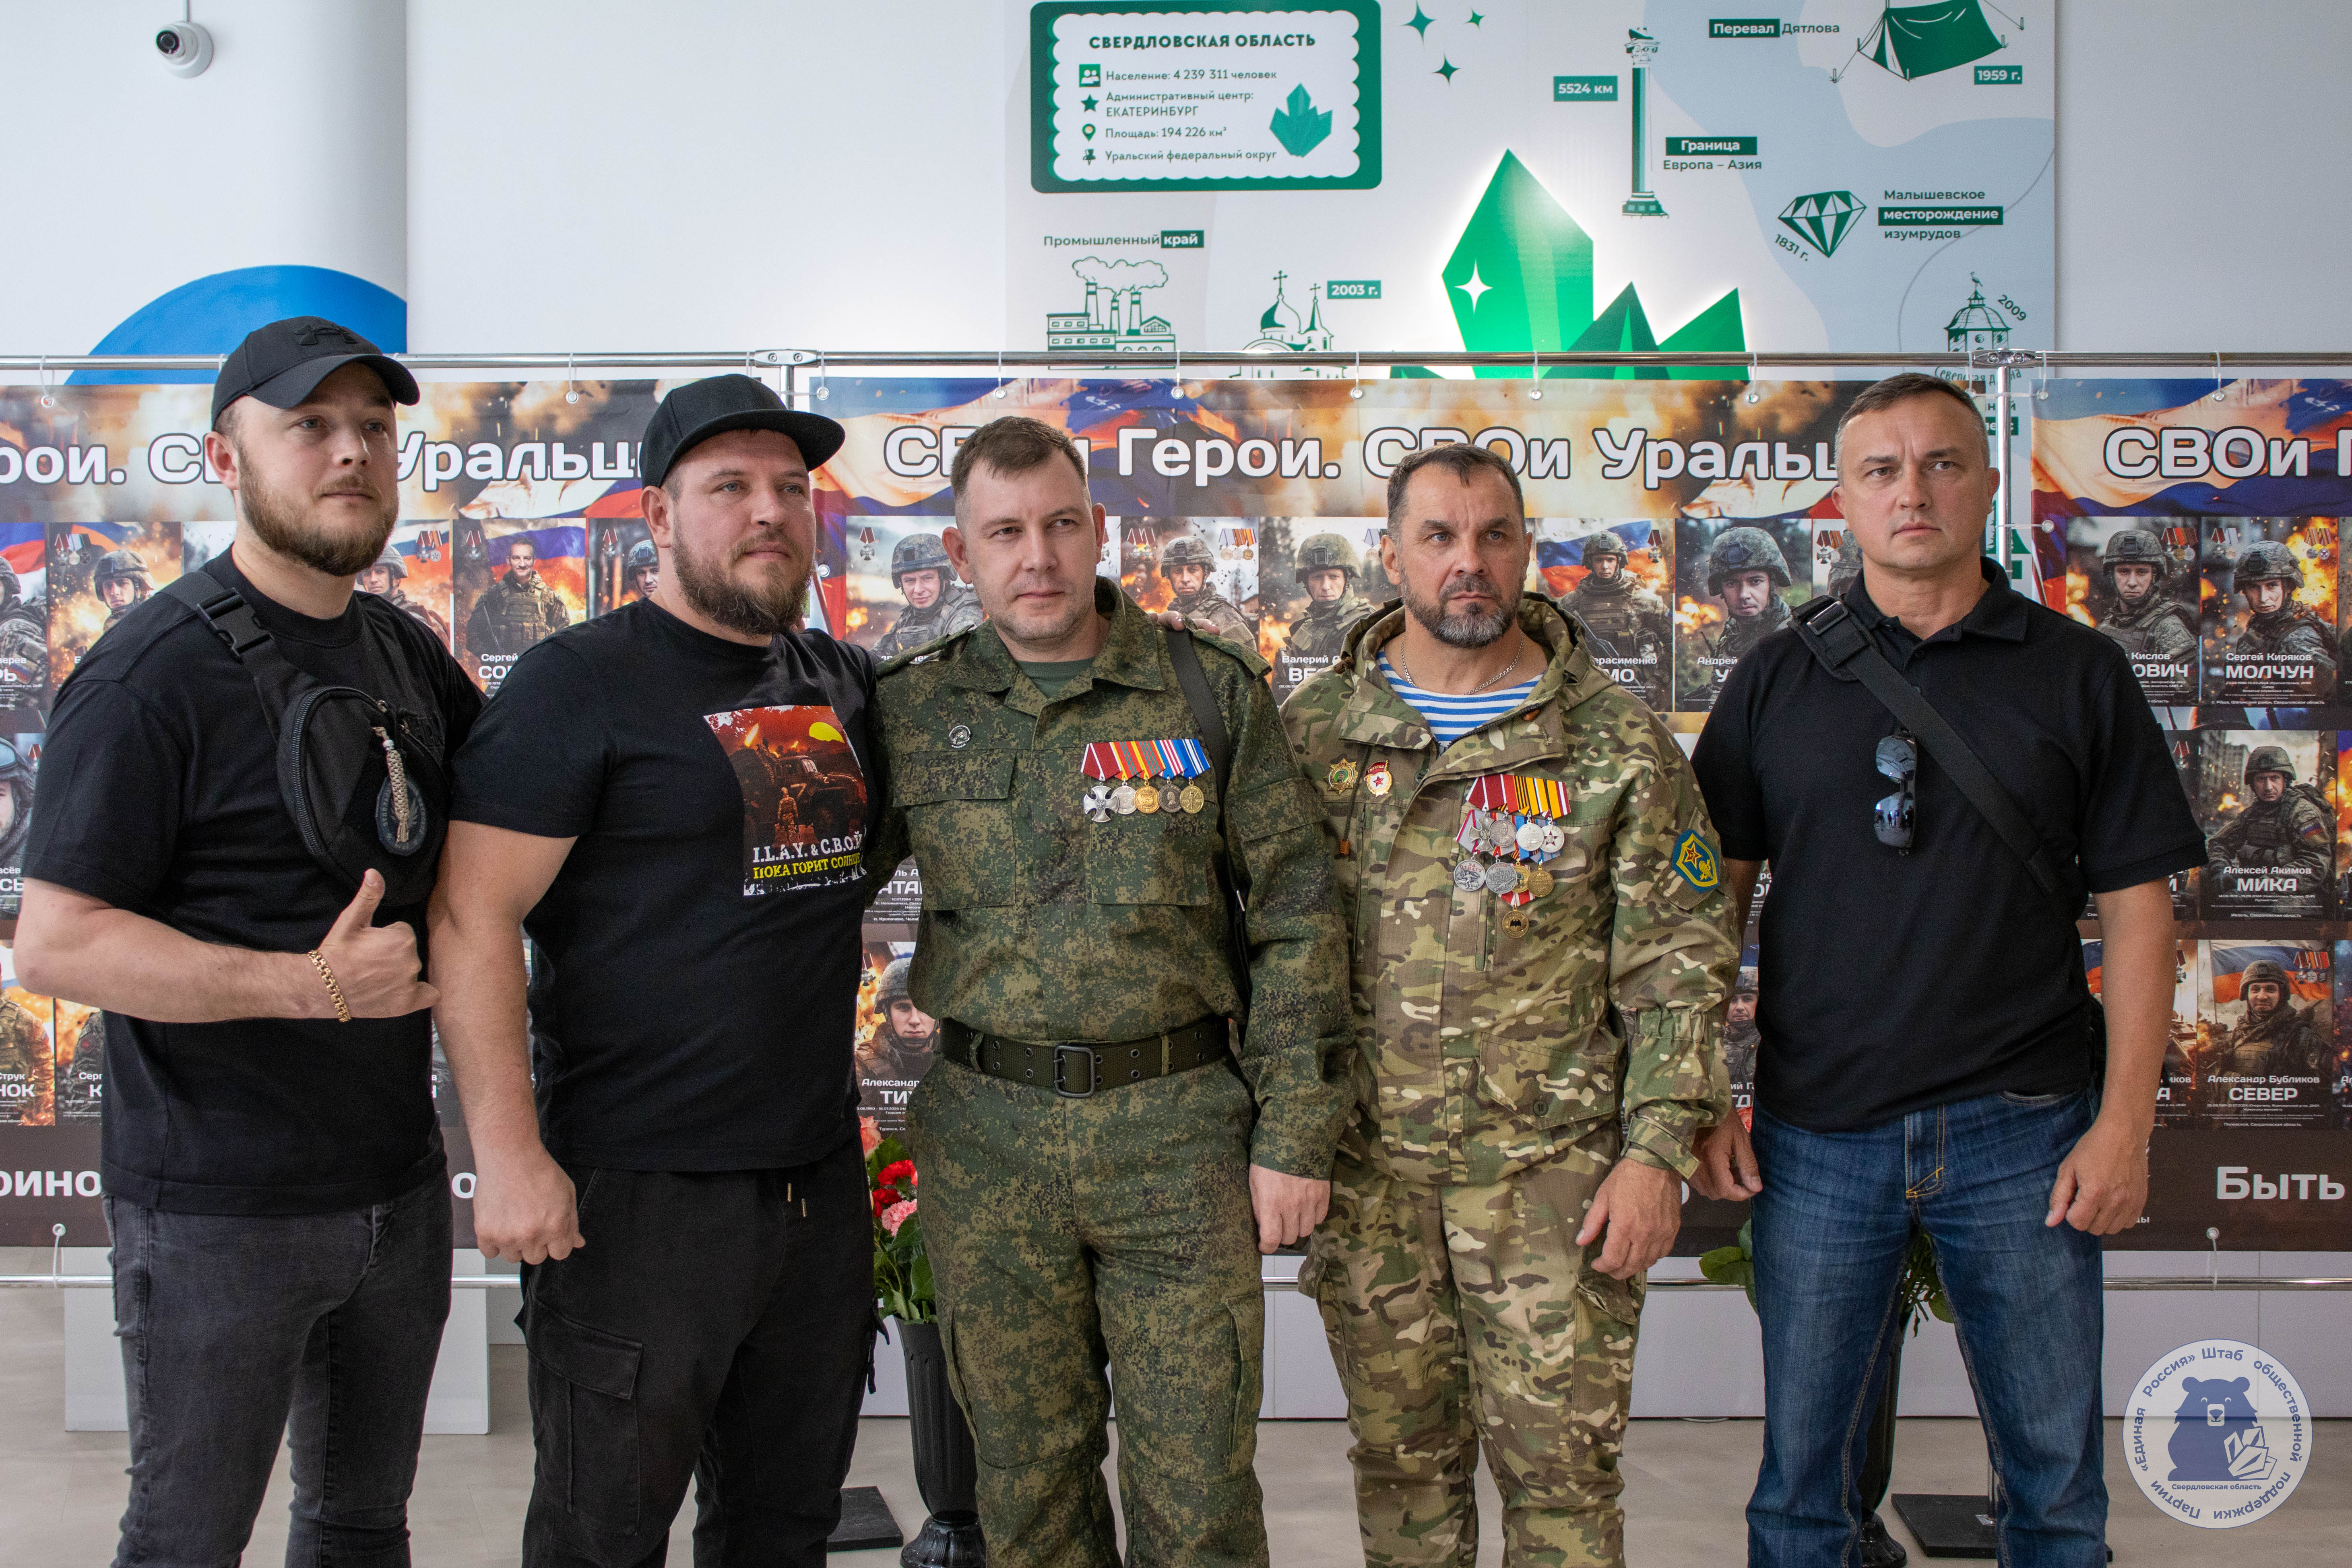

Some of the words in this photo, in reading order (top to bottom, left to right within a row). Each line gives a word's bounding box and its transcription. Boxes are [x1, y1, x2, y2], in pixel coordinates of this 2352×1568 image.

[1714, 23, 1774, 35] Перевал
[1782, 23, 1840, 35] Дятлова
[1089, 35, 1230, 50] СВЕРДЛОВСКАЯ
[1235, 34, 1316, 48] ОБЛАСТЬ
[1106, 71, 1171, 81] Население:
[1173, 70, 1181, 79] 4
[1184, 70, 1205, 79] 239
[1209, 69, 1228, 79] 311
[1231, 70, 1277, 79] человек
[1977, 69, 2007, 81] 1959
[2012, 71, 2021, 81] г.
[1558, 83, 1591, 94] 5524
[1594, 85, 1613, 94] км
[1106, 90, 1215, 102] Административный
[1218, 91, 1254, 102] центр:
[1106, 106, 1199, 117] ЕКАТЕРИНБУРГ
[1106, 128, 1159, 139] Площадь:
[1161, 127, 1182, 137] 194
[1185, 127, 1206, 137] 226
[1681, 140, 1740, 153] Граница
[1105, 149, 1164, 160] Уральский
[1167, 149, 1242, 163] федеральный
[1245, 151, 1277, 162] округ
[1663, 160, 1714, 172] Европа
[1728, 159, 1762, 170] Азия
[1884, 190, 1985, 200] Малышевское
[1883, 209, 1999, 222] месторождение
[1043, 233, 1160, 248] Промышленный
[1164, 233, 1198, 247] край
[1884, 229, 1961, 242] изумрудов
[1774, 233, 1801, 255] 1831
[1800, 250, 1810, 262] г.
[1331, 284, 1365, 296] 2003
[1368, 286, 1378, 296] г.
[1997, 293, 2027, 322] 2009
[1117, 427, 1341, 486] Герои.
[2104, 426, 2311, 479] СВОи
[397, 431, 642, 492] Уральц
[1282, 655, 1328, 664] Валерий
[1697, 656, 1738, 666] Андрей
[2226, 653, 2263, 663] Сергей
[2267, 653, 2312, 661] Киряков
[2225, 665, 2314, 679] МОЛЧУН
[753, 864, 791, 880] ПОКА
[792, 858, 829, 875] ГОРИТ
[831, 852, 861, 869] СОЛНЦЕ
[1460, 865, 1483, 873] ОТВАГУ
[2223, 866, 2268, 874] Алексей
[2270, 866, 2312, 874] Акимов
[2237, 878, 2298, 891] МИКА
[862, 1078, 920, 1087] Александр
[2207, 1075, 2266, 1085] Александр
[2269, 1075, 2320, 1083] Бубликов
[2229, 1087, 2298, 1101] СЕВЕР
[2216, 1166, 2346, 1200] Быть
